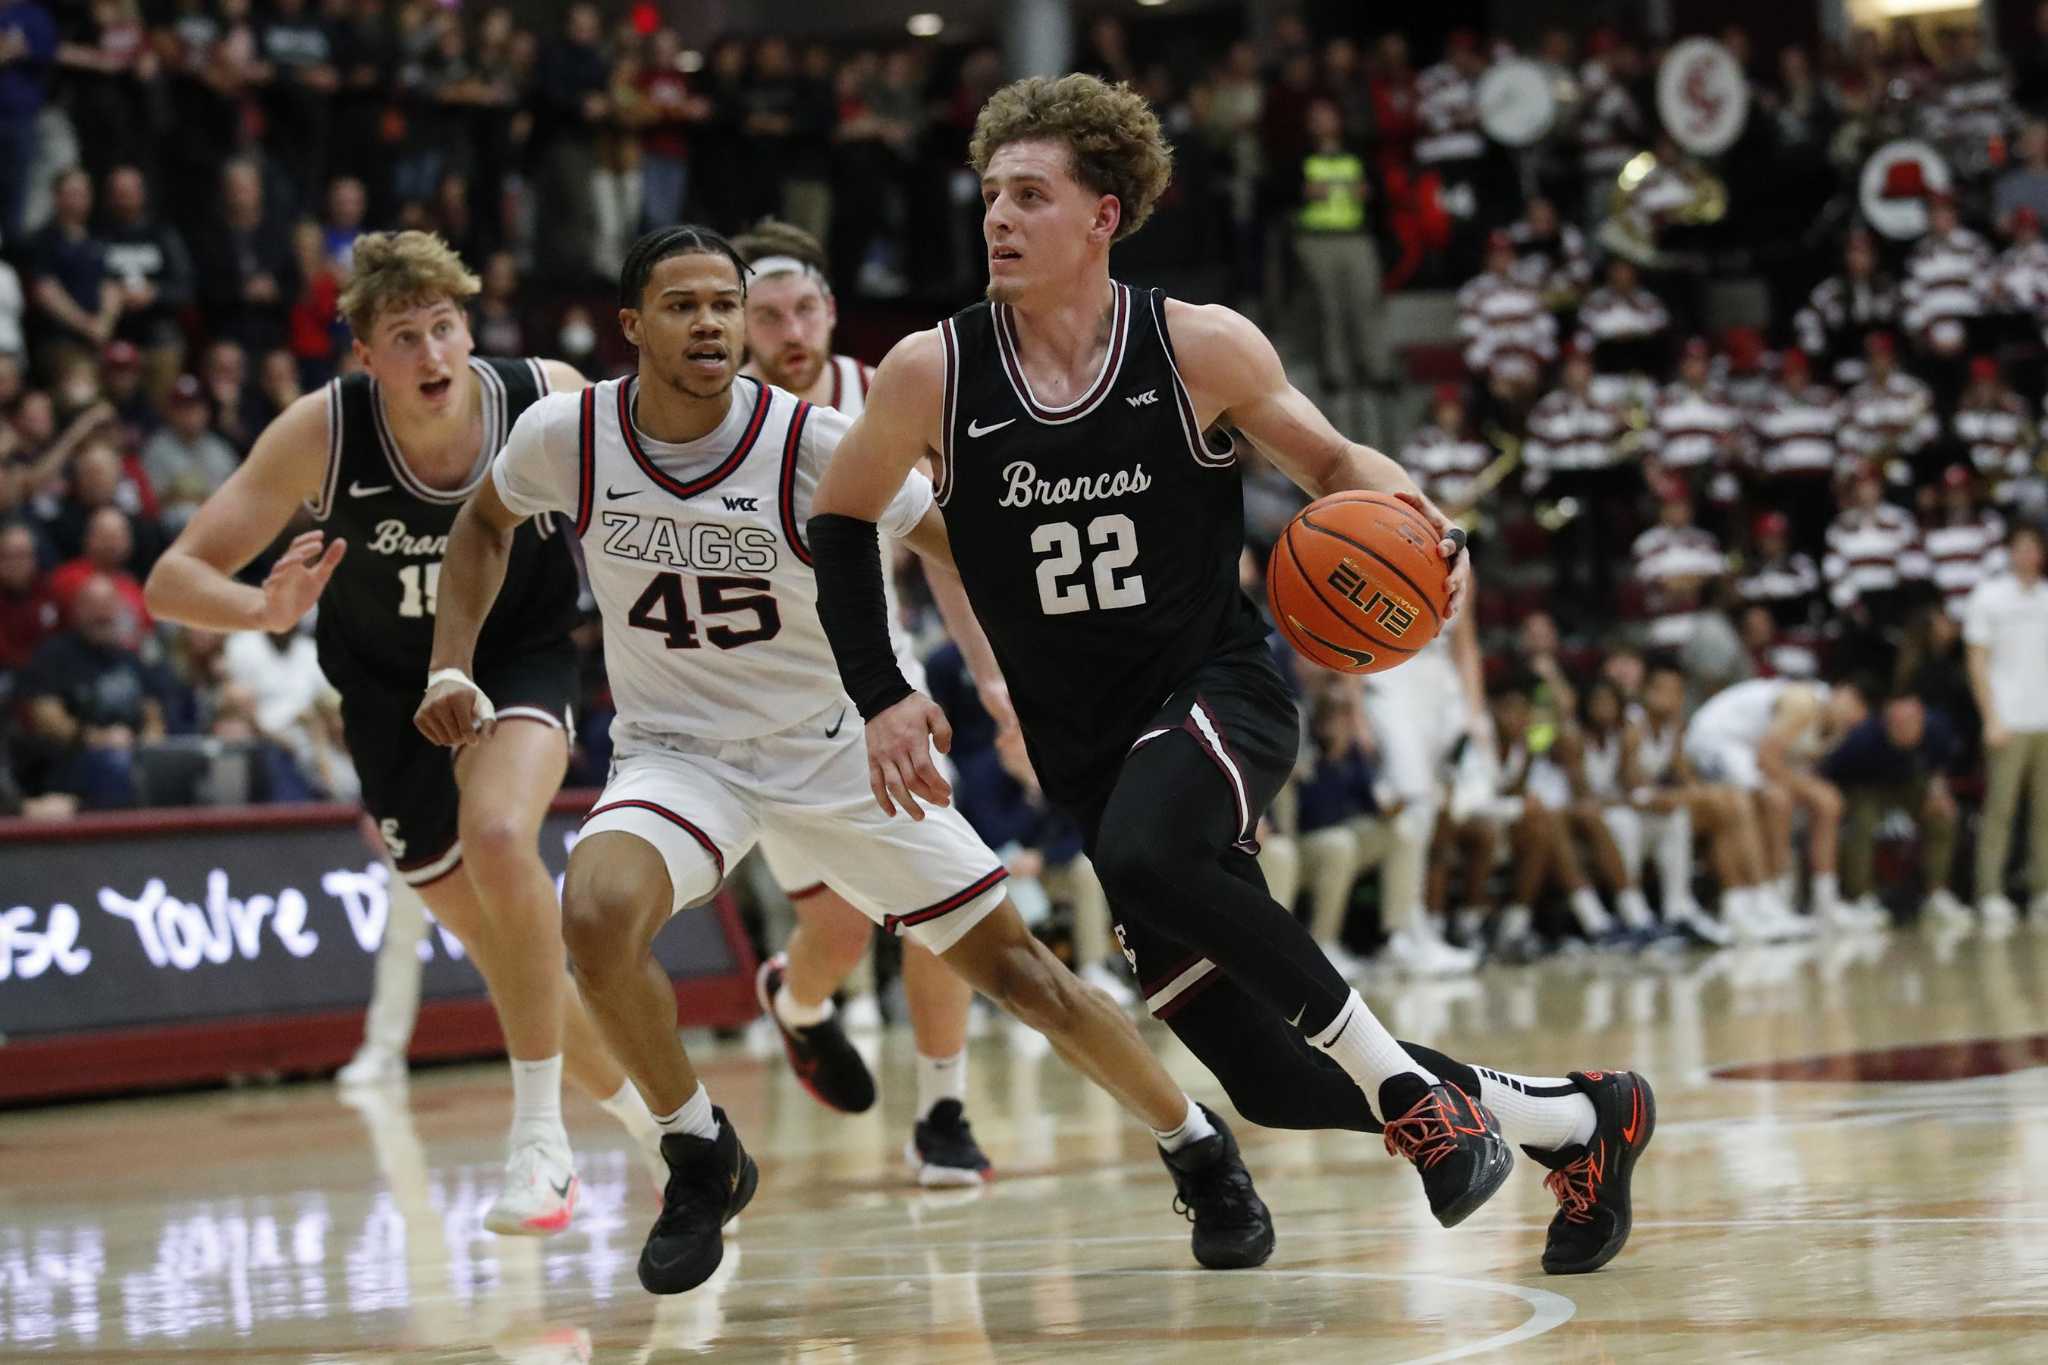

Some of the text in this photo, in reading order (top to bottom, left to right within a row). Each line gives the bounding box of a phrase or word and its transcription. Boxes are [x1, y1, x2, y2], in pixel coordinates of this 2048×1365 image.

[1125, 389, 1159, 407] WCC
[721, 496, 758, 511] WCC
[999, 461, 1151, 507] Broncos
[366, 519, 448, 555] Bron
[602, 511, 777, 573] ZAGS
[1030, 513, 1147, 615] 22
[628, 572, 782, 650] 45
[1327, 562, 1416, 638] ELITE
